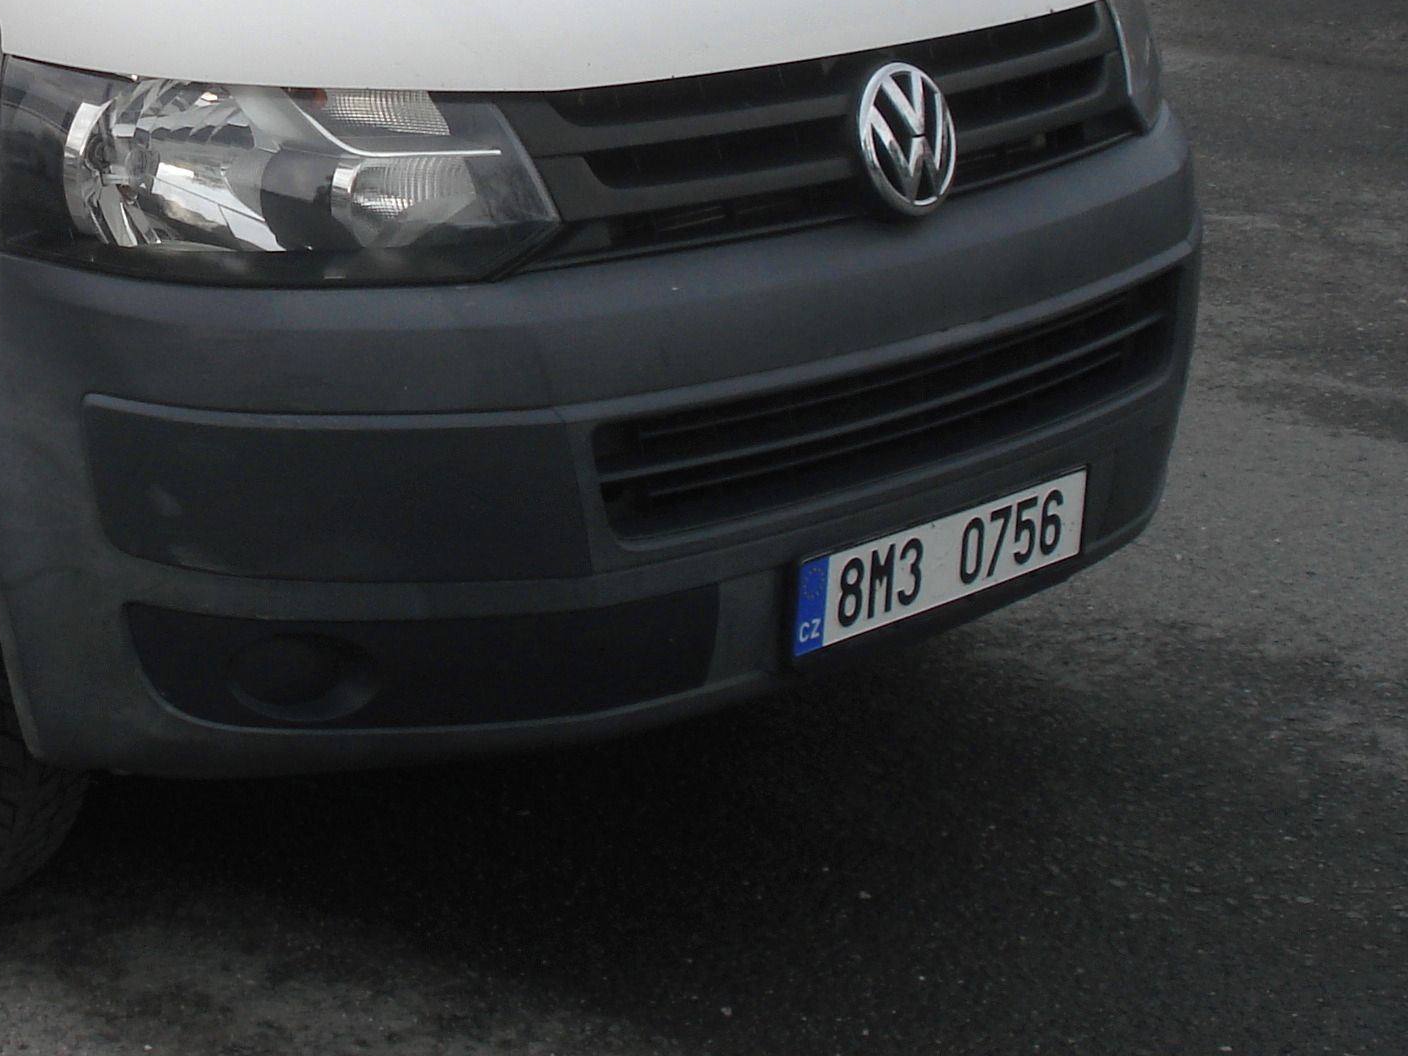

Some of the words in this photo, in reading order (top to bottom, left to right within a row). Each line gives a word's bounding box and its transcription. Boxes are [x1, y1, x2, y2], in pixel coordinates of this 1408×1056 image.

[837, 537, 925, 628] 8M3
[959, 489, 1064, 584] 0756
[798, 617, 823, 644] CZ
